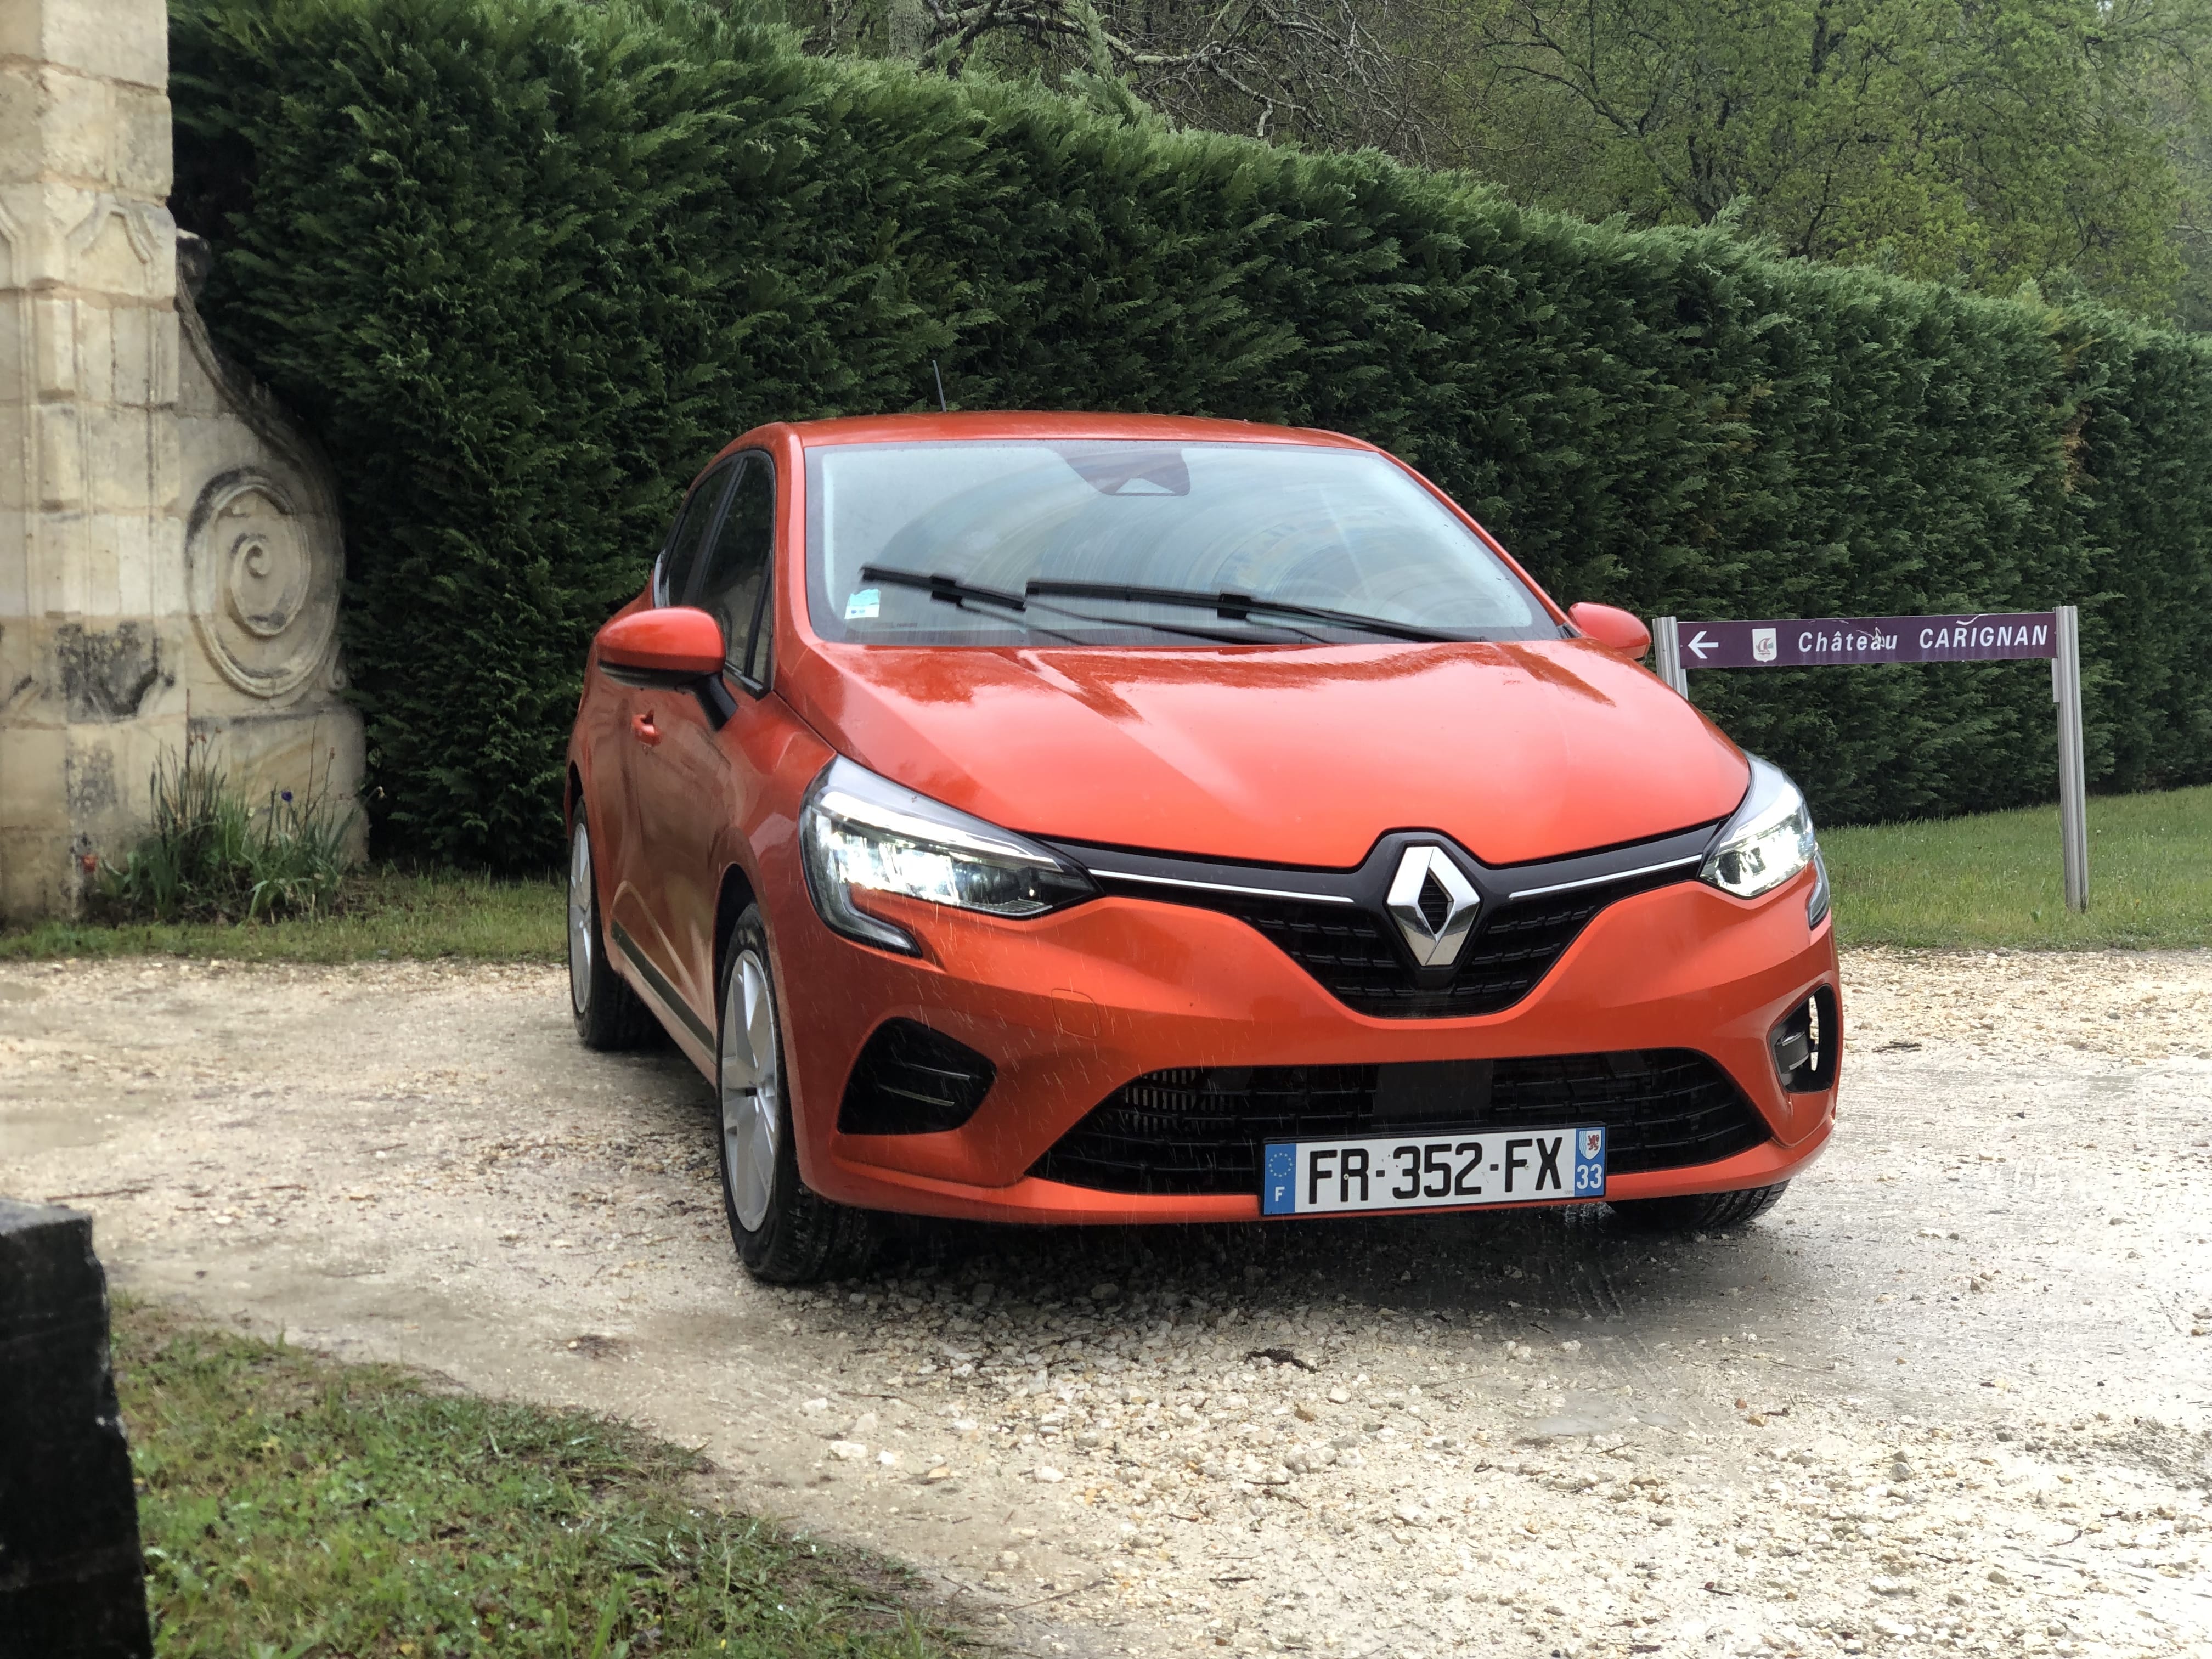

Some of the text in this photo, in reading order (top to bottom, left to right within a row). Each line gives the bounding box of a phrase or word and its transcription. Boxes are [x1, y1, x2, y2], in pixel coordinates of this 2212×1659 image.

[1798, 625, 2047, 652] Château CARIGNAN
[1308, 1137, 1562, 1204] FR-352-FX
[1577, 1164, 1602, 1189] 33
[1274, 1187, 1285, 1201] F
